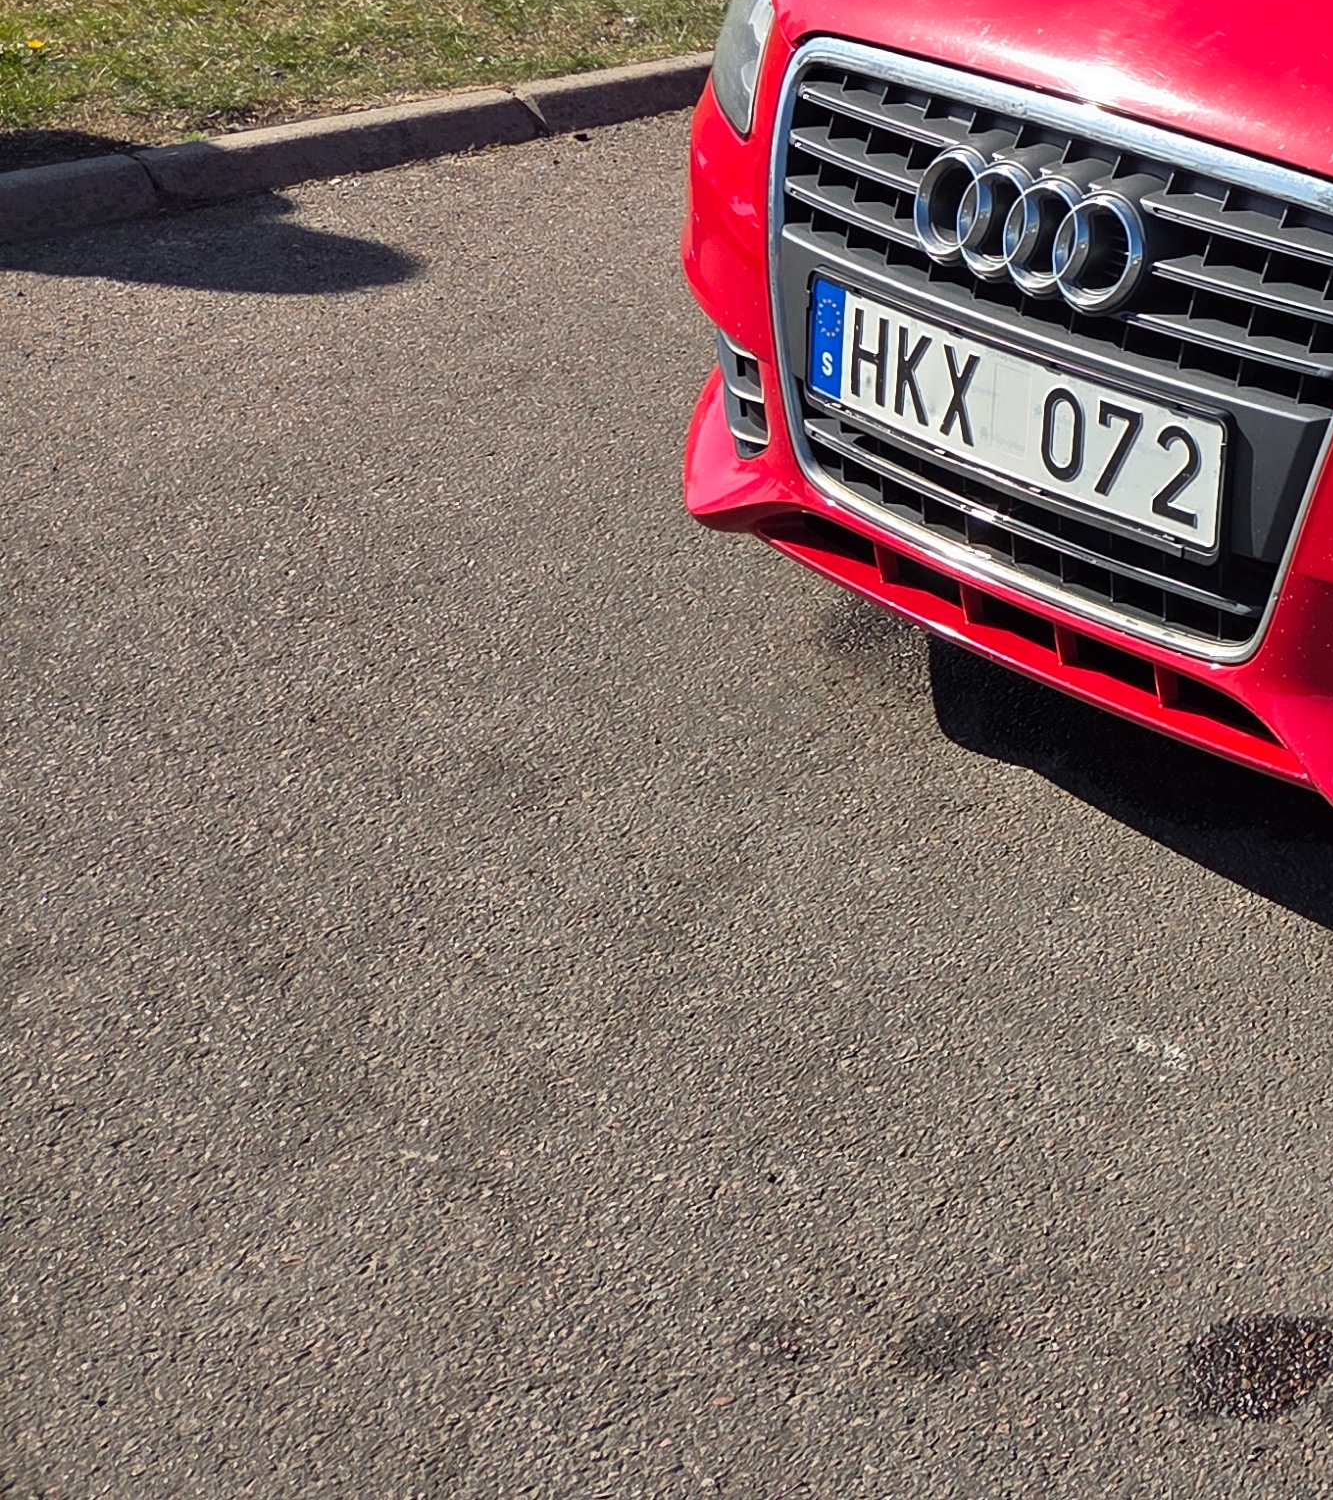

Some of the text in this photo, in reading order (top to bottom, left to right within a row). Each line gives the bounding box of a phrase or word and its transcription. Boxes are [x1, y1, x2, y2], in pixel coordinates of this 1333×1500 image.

[820, 351, 833, 377] S
[850, 306, 1203, 530] HKX 072
